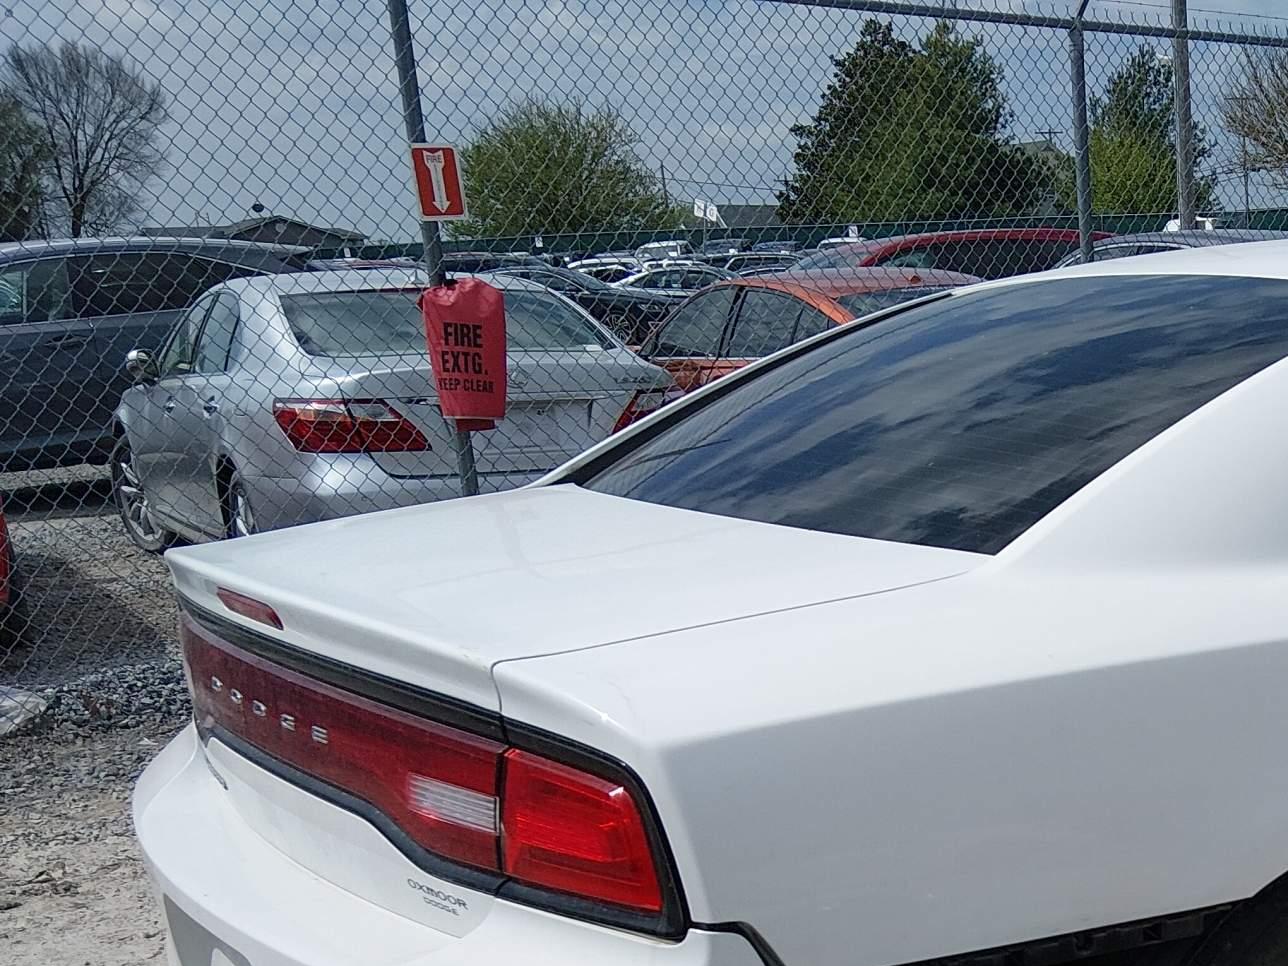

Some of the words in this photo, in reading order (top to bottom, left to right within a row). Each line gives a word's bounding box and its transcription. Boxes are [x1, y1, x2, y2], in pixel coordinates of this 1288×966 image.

[426, 154, 443, 164] FIRE
[443, 322, 483, 348] FIRE
[441, 350, 489, 376] EXTG.
[463, 379, 495, 393] CLEAR
[210, 675, 329, 745] DODGE
[407, 878, 469, 911] OXMOOR
